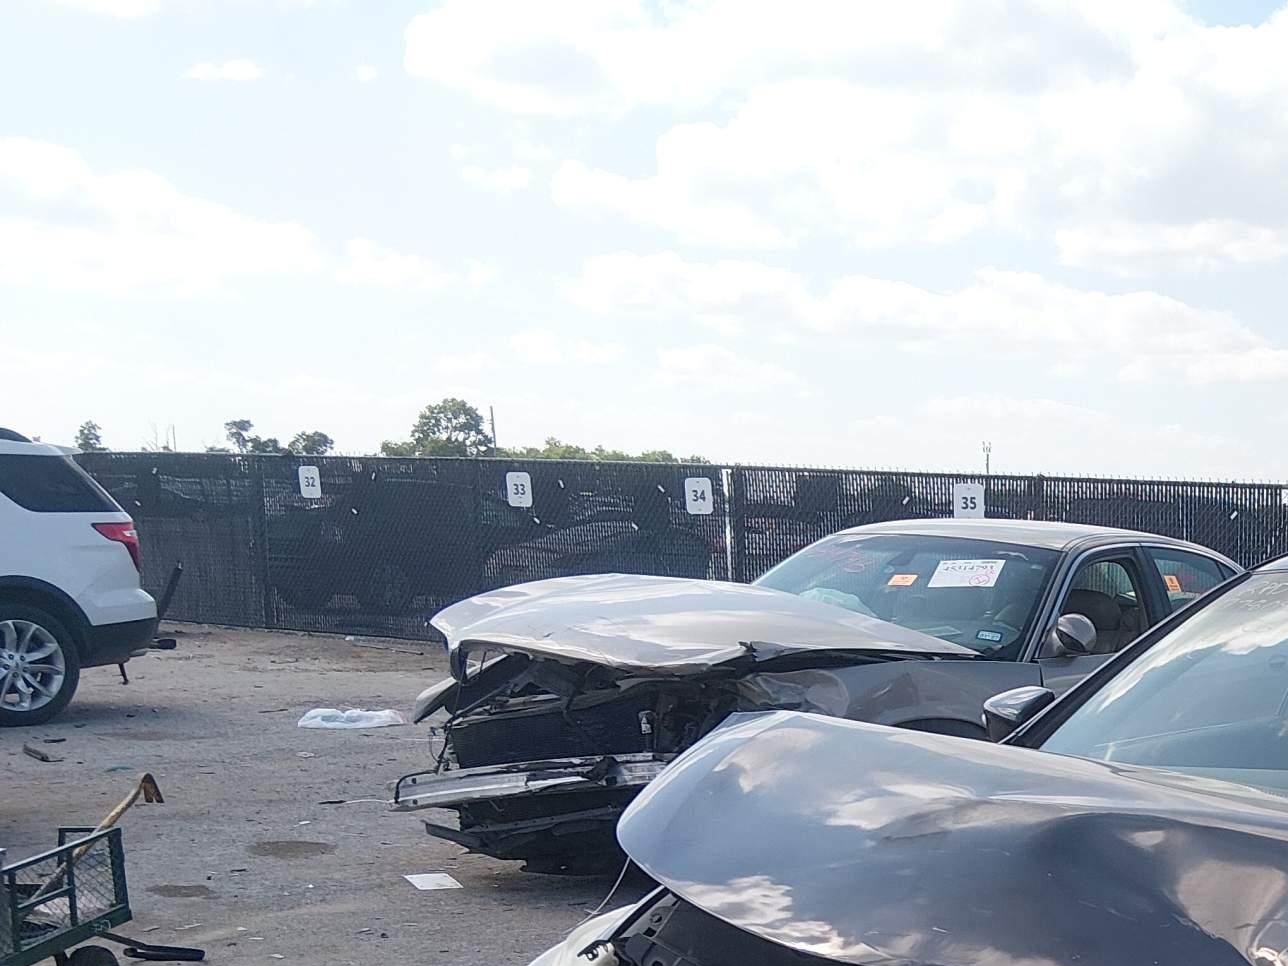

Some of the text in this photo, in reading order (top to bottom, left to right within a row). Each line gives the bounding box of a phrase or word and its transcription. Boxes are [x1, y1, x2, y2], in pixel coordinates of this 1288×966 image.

[304, 476, 316, 488] 32
[512, 483, 526, 496] 33
[691, 489, 706, 502] 34
[961, 496, 977, 510] 35
